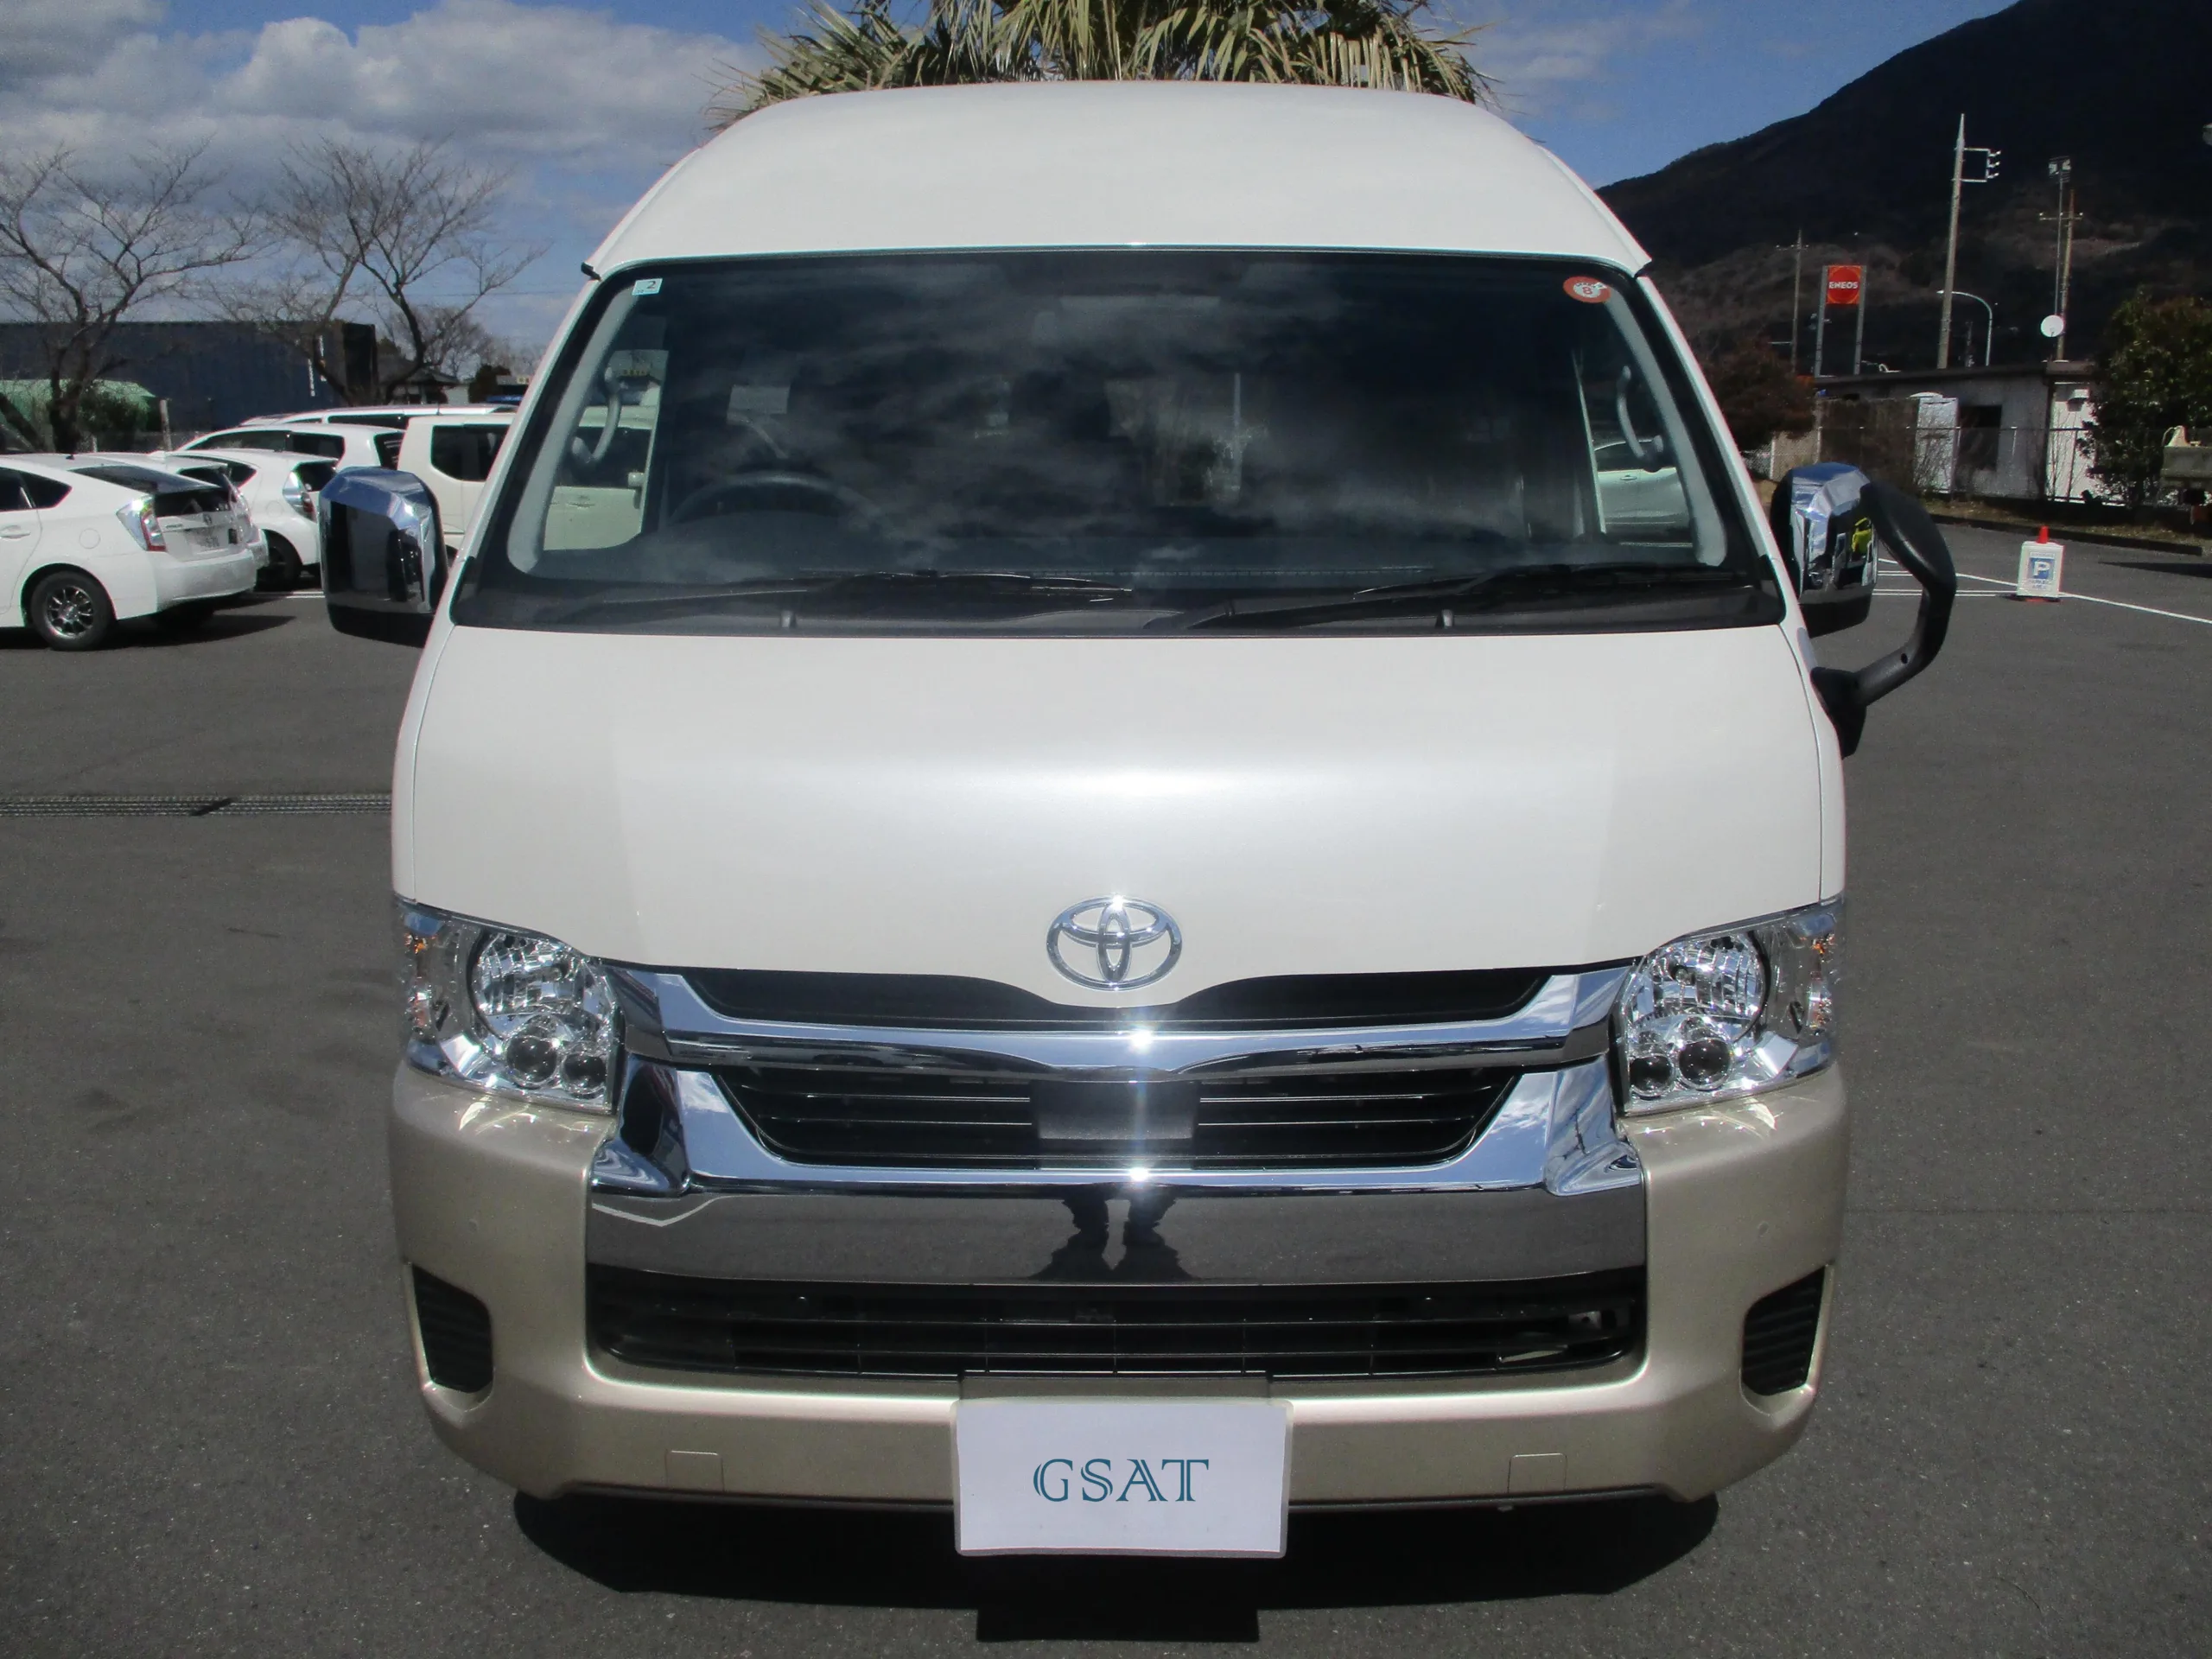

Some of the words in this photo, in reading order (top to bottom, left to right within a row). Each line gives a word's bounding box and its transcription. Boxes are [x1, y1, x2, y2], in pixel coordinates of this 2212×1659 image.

[646, 280, 657, 289] 2
[1828, 281, 1859, 289] ENEOS
[2033, 561, 2050, 576] P
[1033, 1459, 1210, 1502] GSAT
